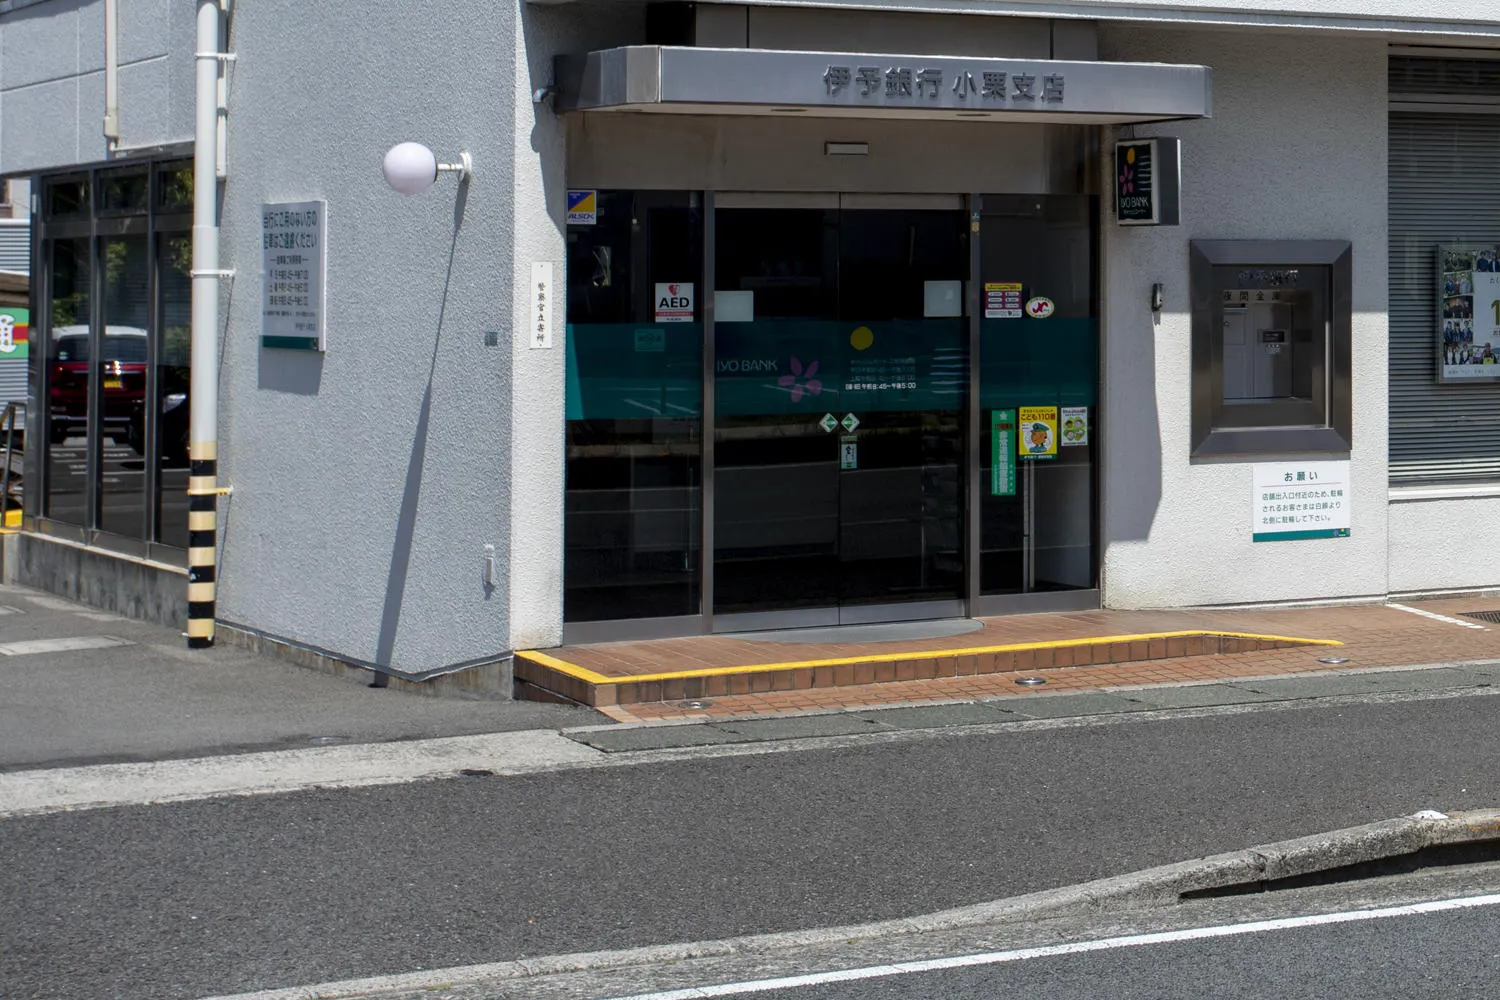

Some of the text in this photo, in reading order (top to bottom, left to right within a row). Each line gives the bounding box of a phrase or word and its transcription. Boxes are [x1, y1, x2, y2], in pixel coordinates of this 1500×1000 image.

[823, 65, 1065, 104] 伊予銀行 小栗支店
[658, 297, 690, 308] AED
[716, 359, 778, 371] IYO BANK
[1284, 471, 1318, 482] お願い
